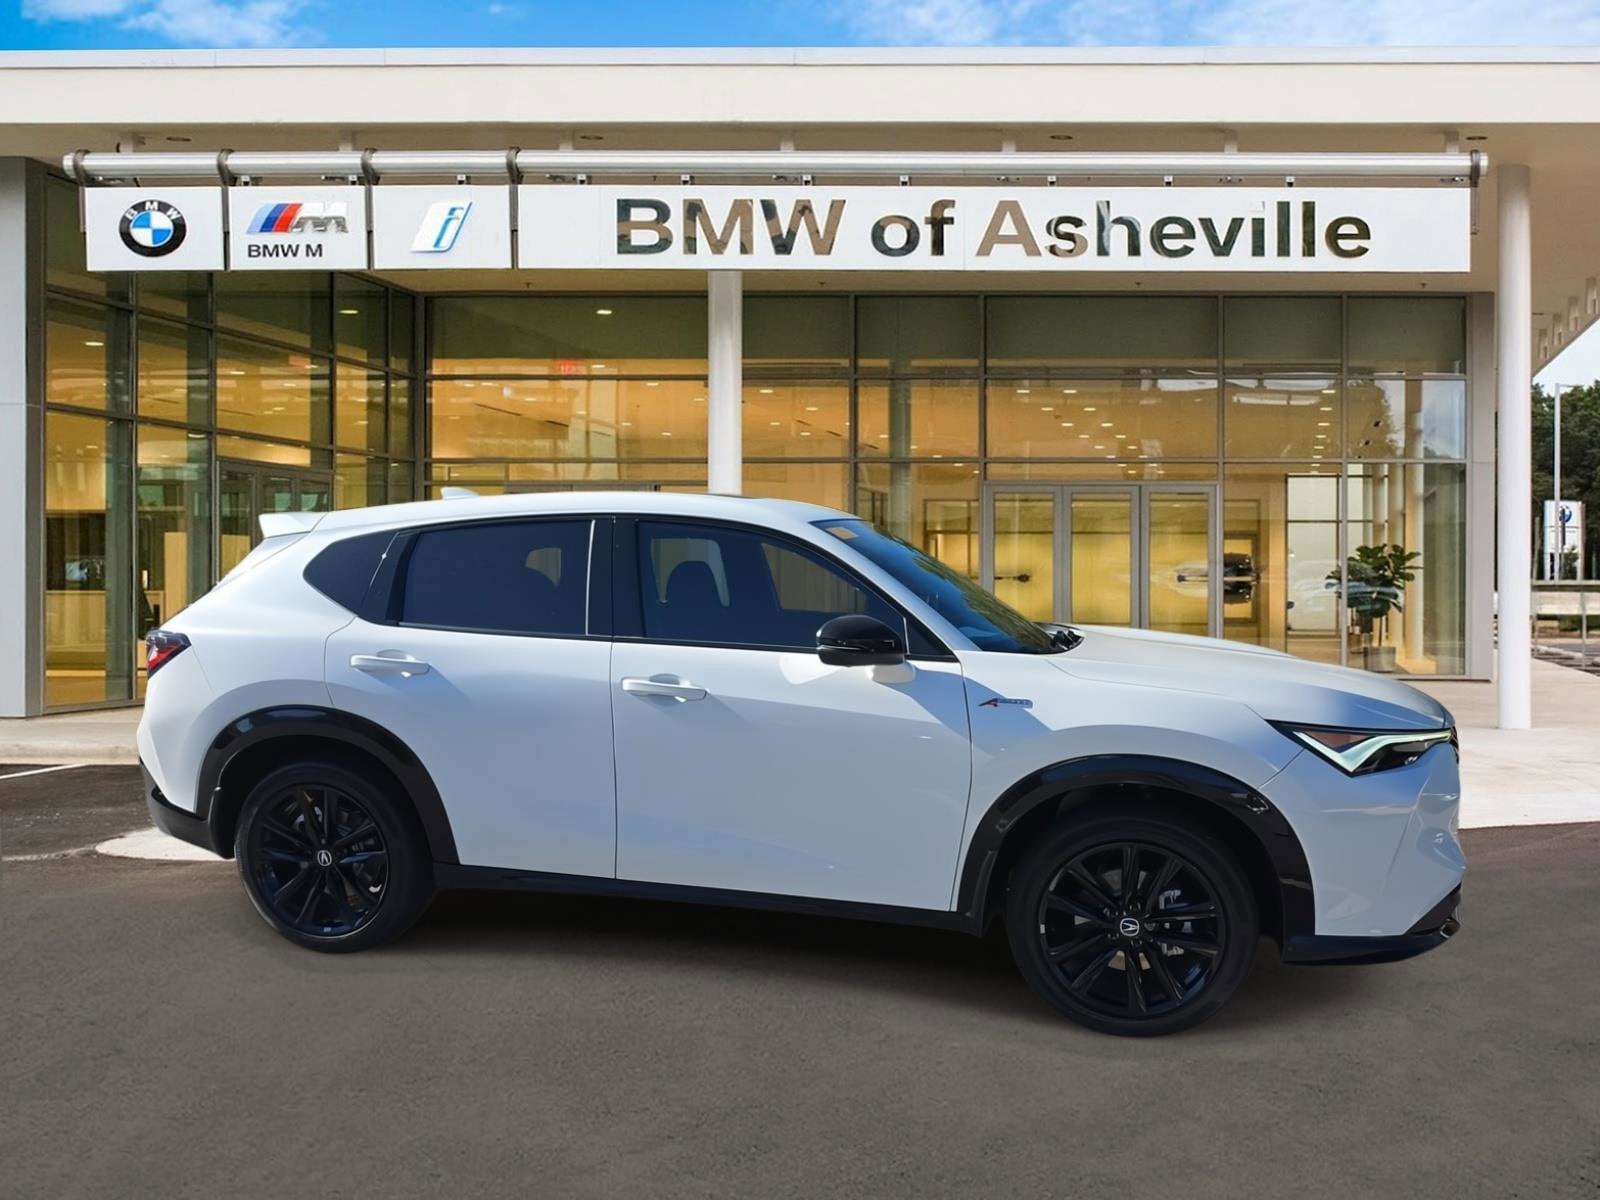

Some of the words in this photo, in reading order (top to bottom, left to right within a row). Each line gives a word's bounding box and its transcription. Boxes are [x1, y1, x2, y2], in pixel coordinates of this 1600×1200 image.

[125, 201, 181, 220] BMW
[616, 198, 847, 256] BMW
[871, 199, 956, 258] of
[975, 199, 1371, 259] Asheville
[247, 243, 300, 258] BMW
[305, 243, 323, 258] M
